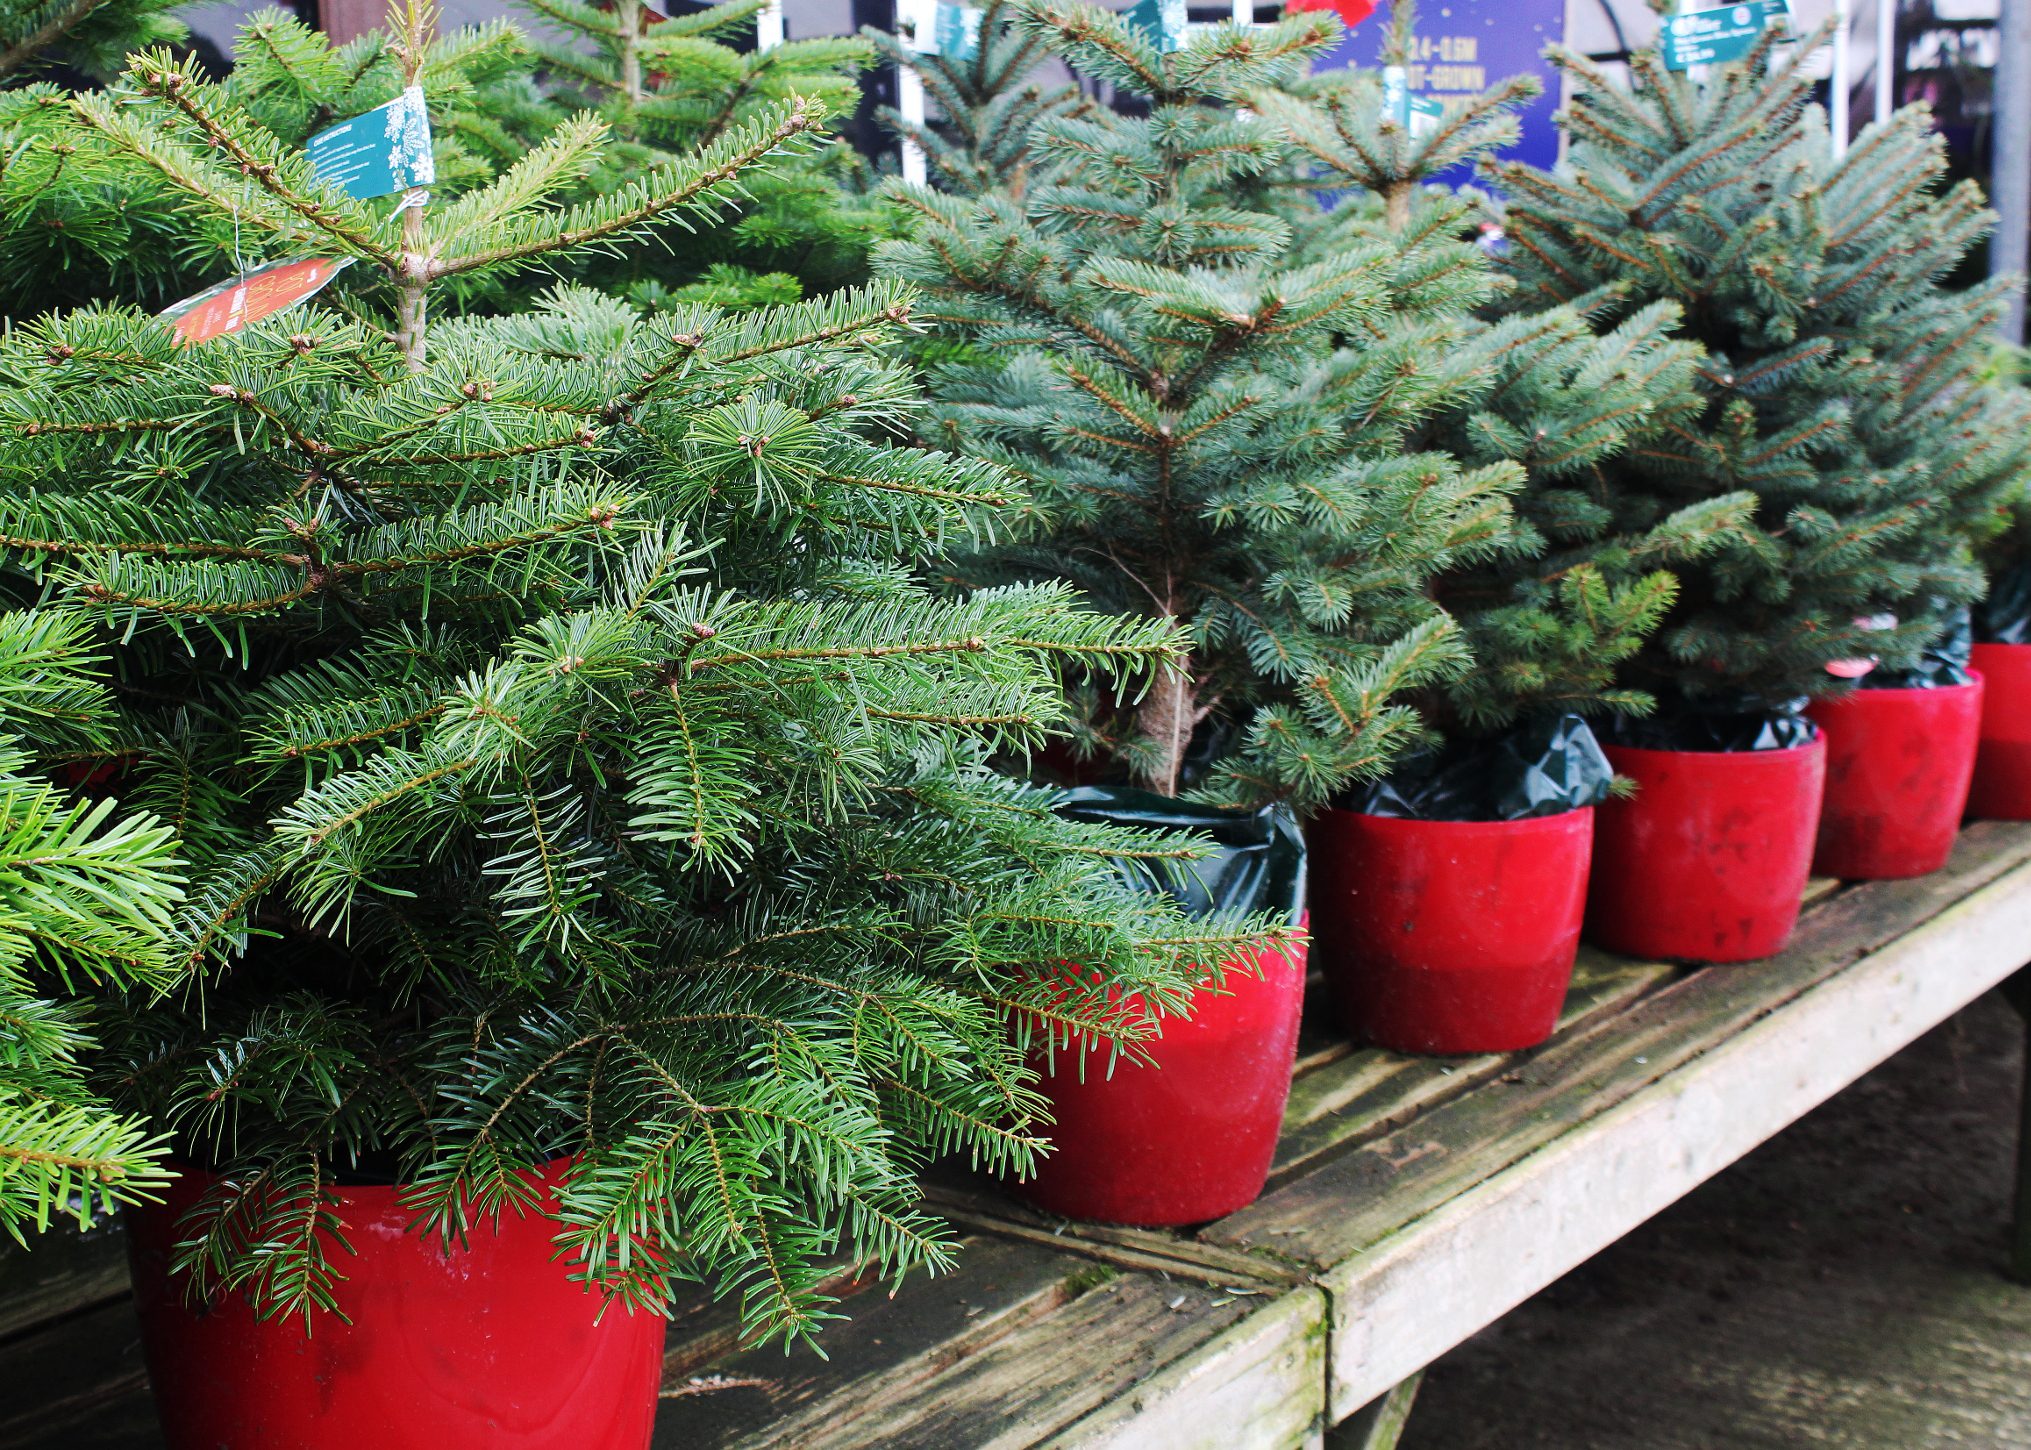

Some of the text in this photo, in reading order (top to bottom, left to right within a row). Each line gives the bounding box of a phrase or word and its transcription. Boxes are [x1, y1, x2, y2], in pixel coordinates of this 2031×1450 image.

[324, 124, 353, 142] INSTRUCTIONS
[275, 271, 305, 297] POT
[225, 287, 247, 331] CHRISTMAS TREE
